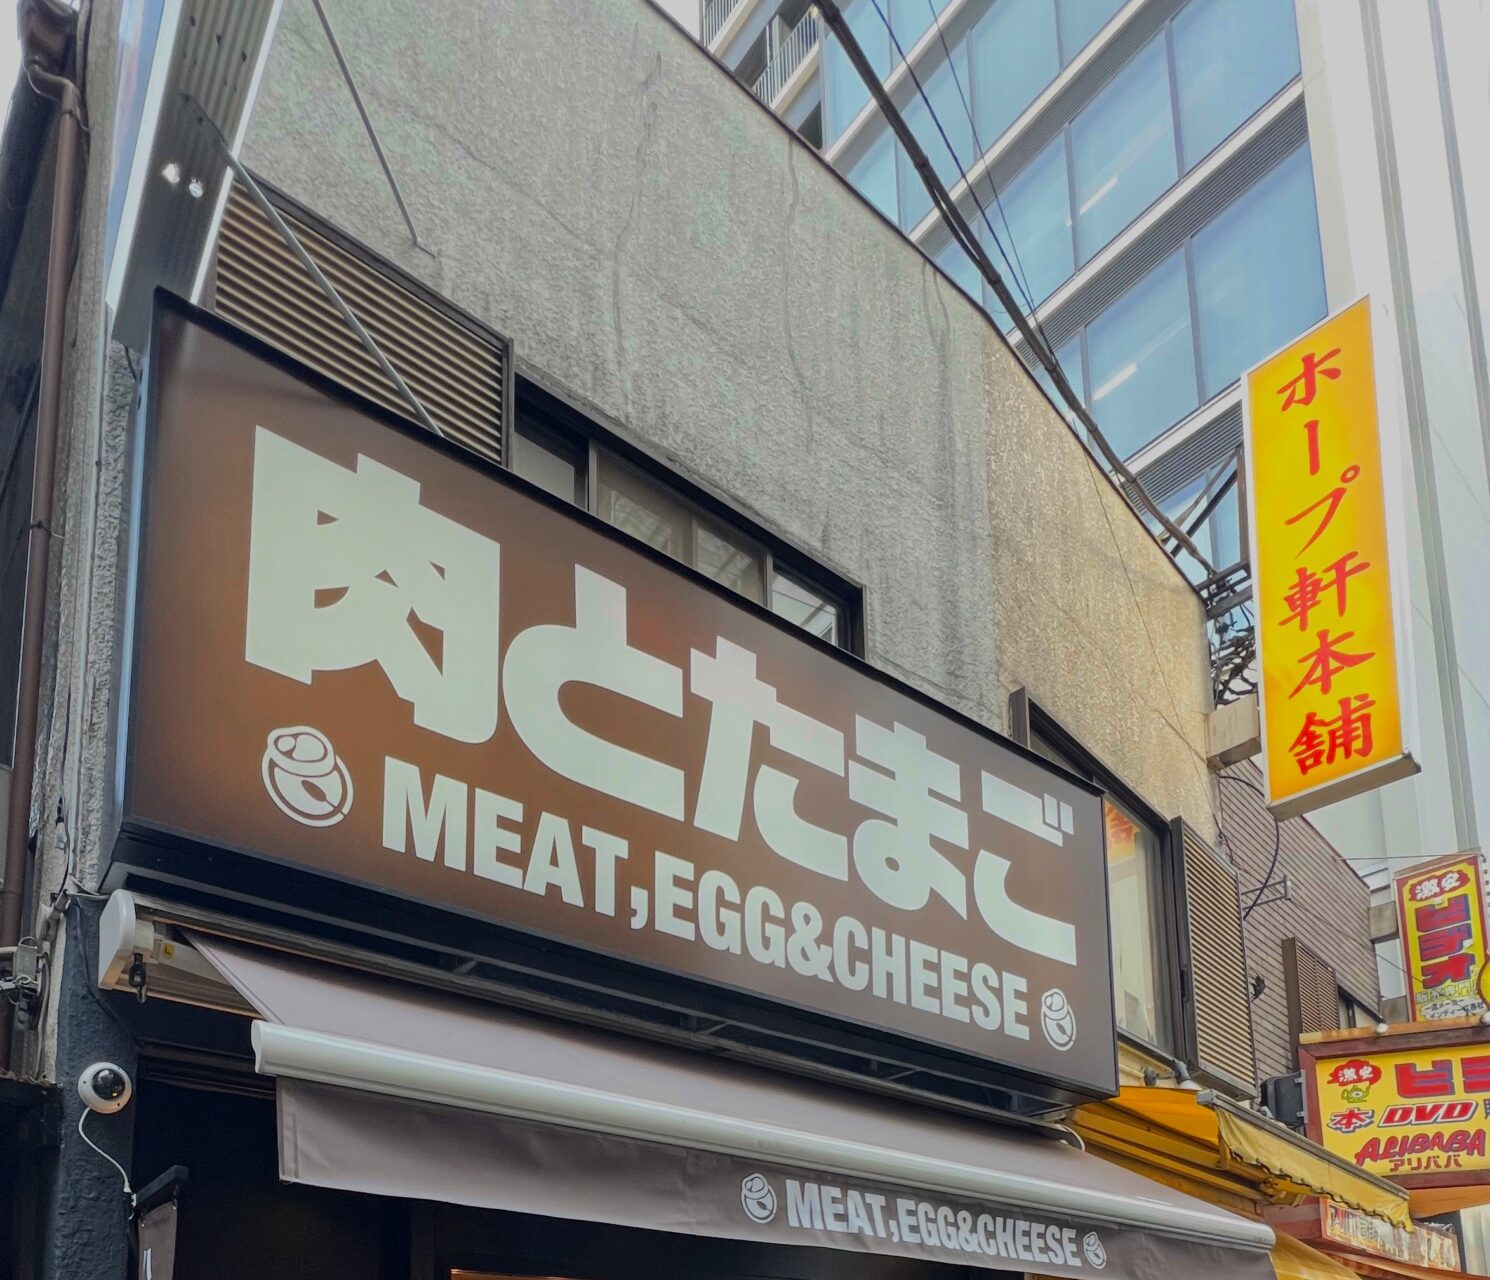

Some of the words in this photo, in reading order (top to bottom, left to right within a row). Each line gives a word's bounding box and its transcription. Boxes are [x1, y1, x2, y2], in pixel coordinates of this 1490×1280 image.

[1277, 347, 1376, 776] ホープ軒本舗
[245, 425, 1078, 967] 肉とたまご
[382, 755, 1031, 1042] MEAT,EGG&CHEESE
[1338, 1065, 1373, 1083] 激安
[1328, 1107, 1375, 1133] 本
[1378, 1100, 1478, 1128] DVD
[1354, 1129, 1486, 1167] ALIBABA
[1388, 1154, 1463, 1172] アリババ
[784, 1178, 1083, 1267] MEAT,EGG&CHEESE
